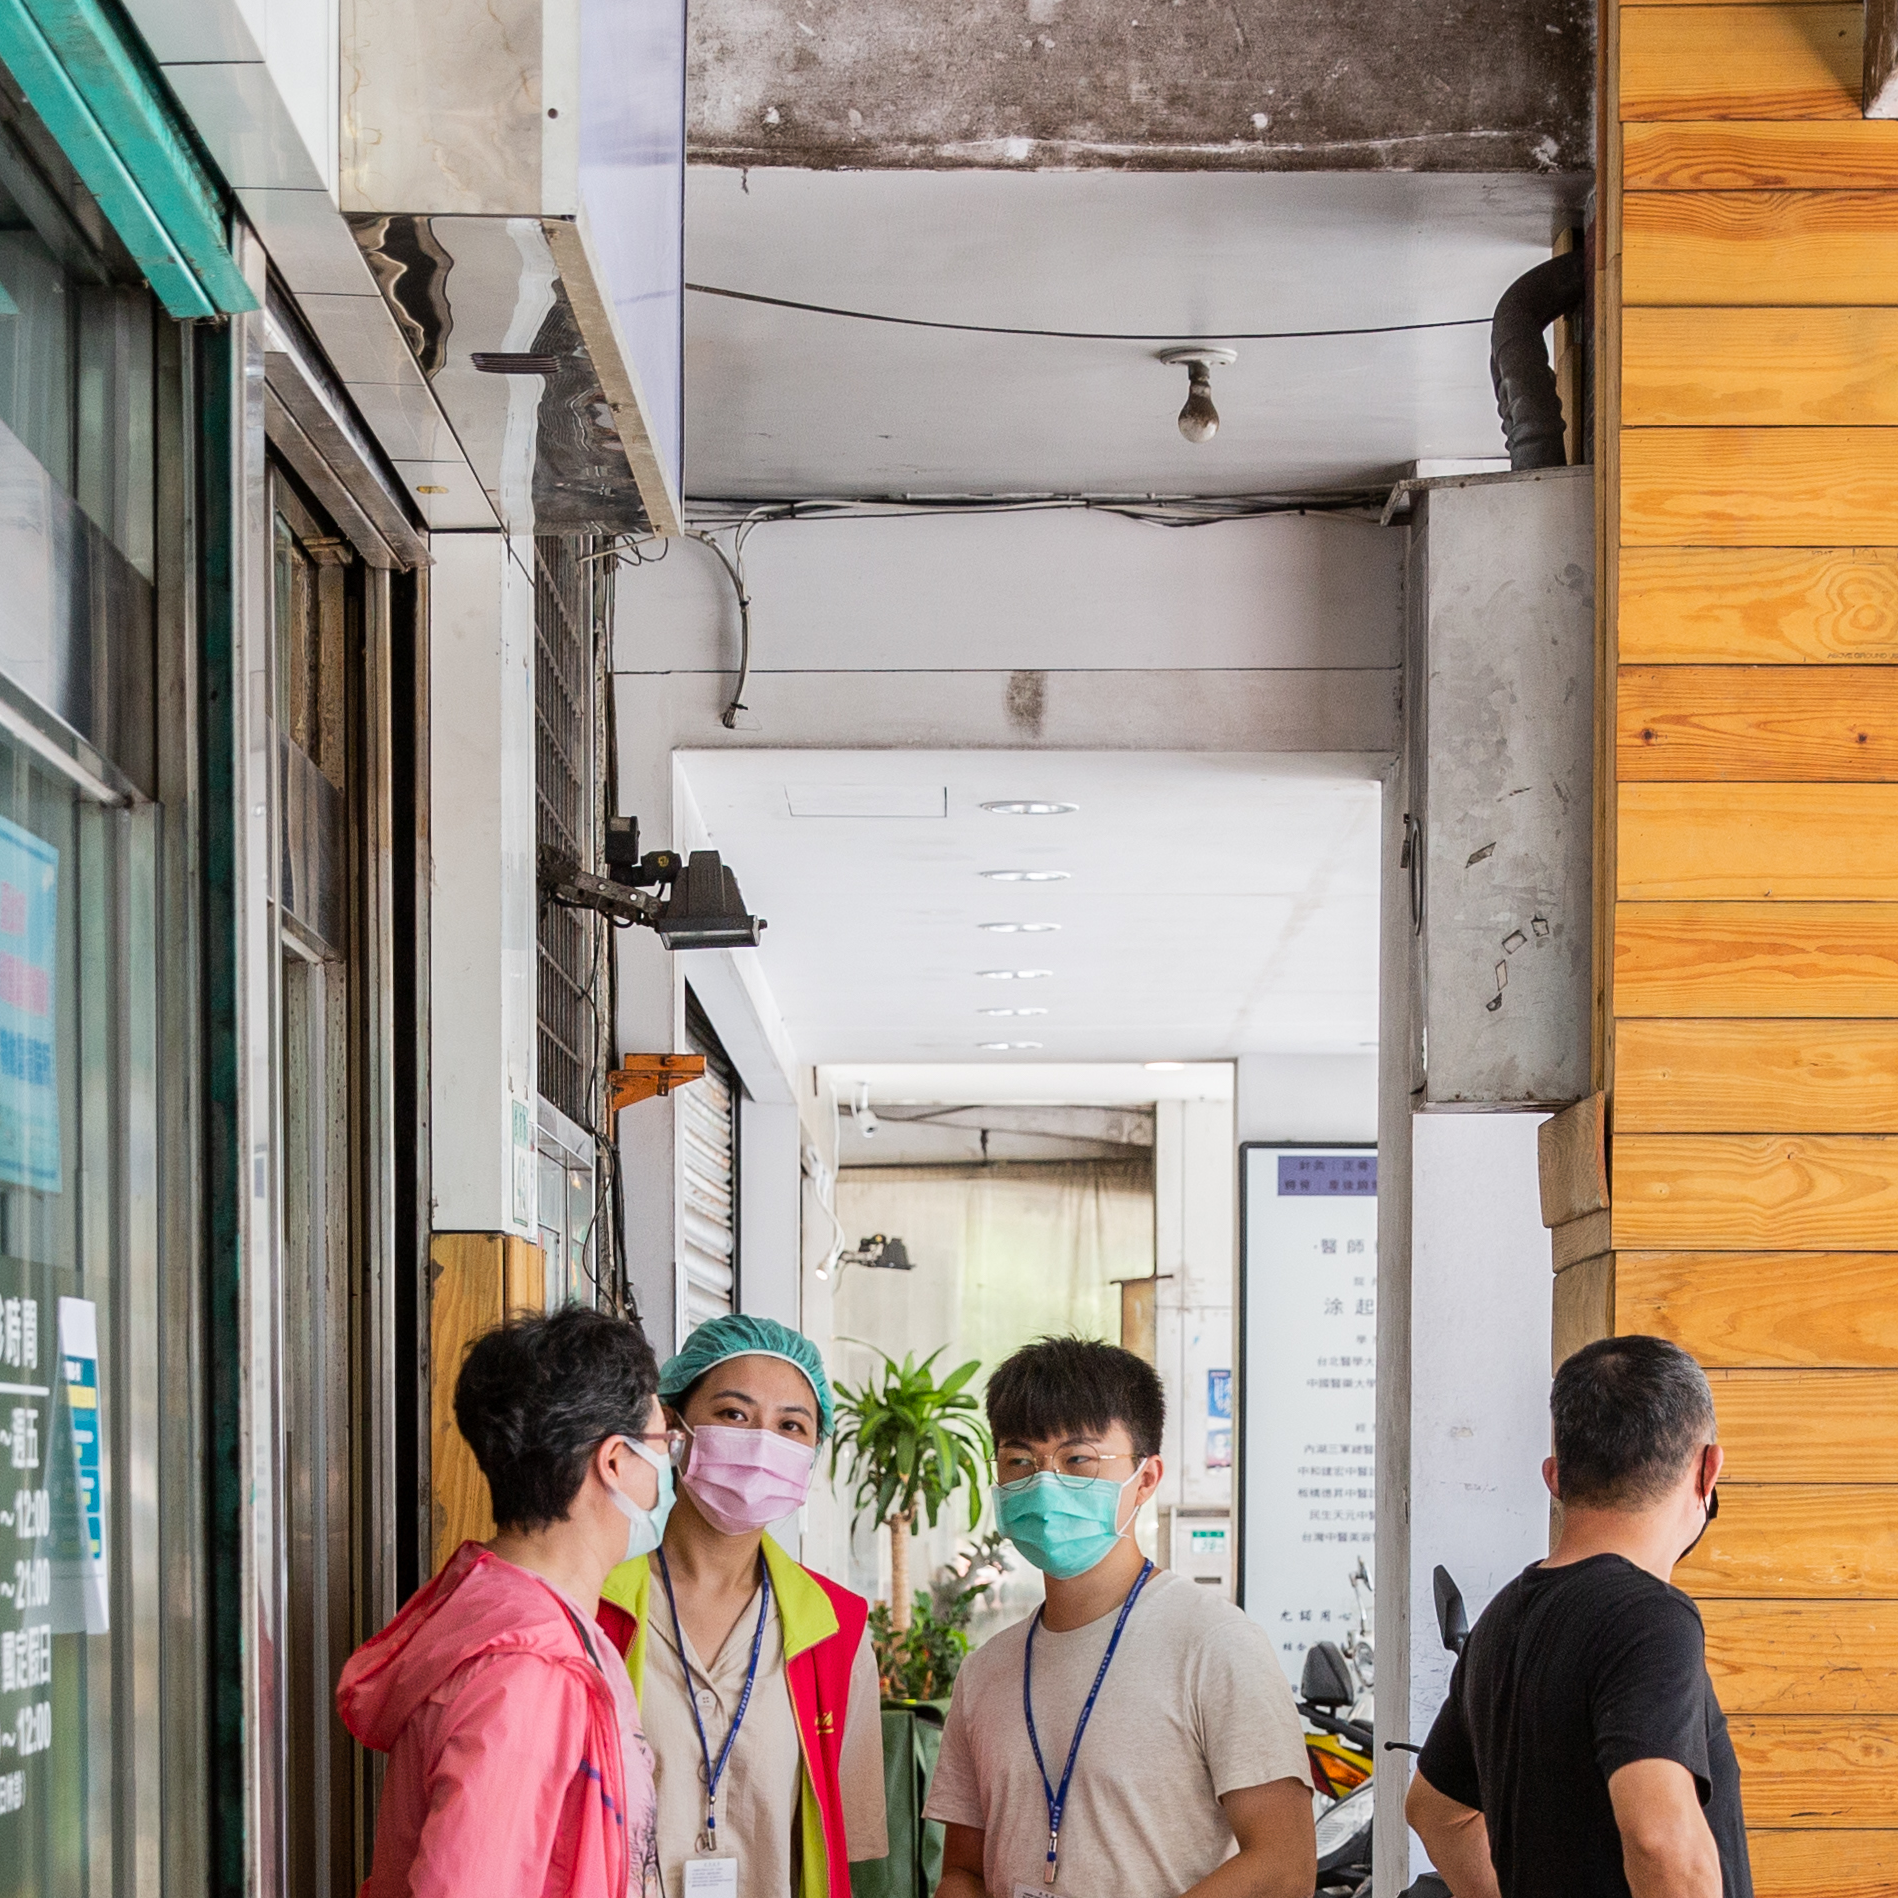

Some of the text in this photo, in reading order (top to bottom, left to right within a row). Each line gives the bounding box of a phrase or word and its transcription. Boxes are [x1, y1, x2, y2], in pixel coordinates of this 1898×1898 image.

[1301, 1531, 1377, 1542] 台灣中醫美容
